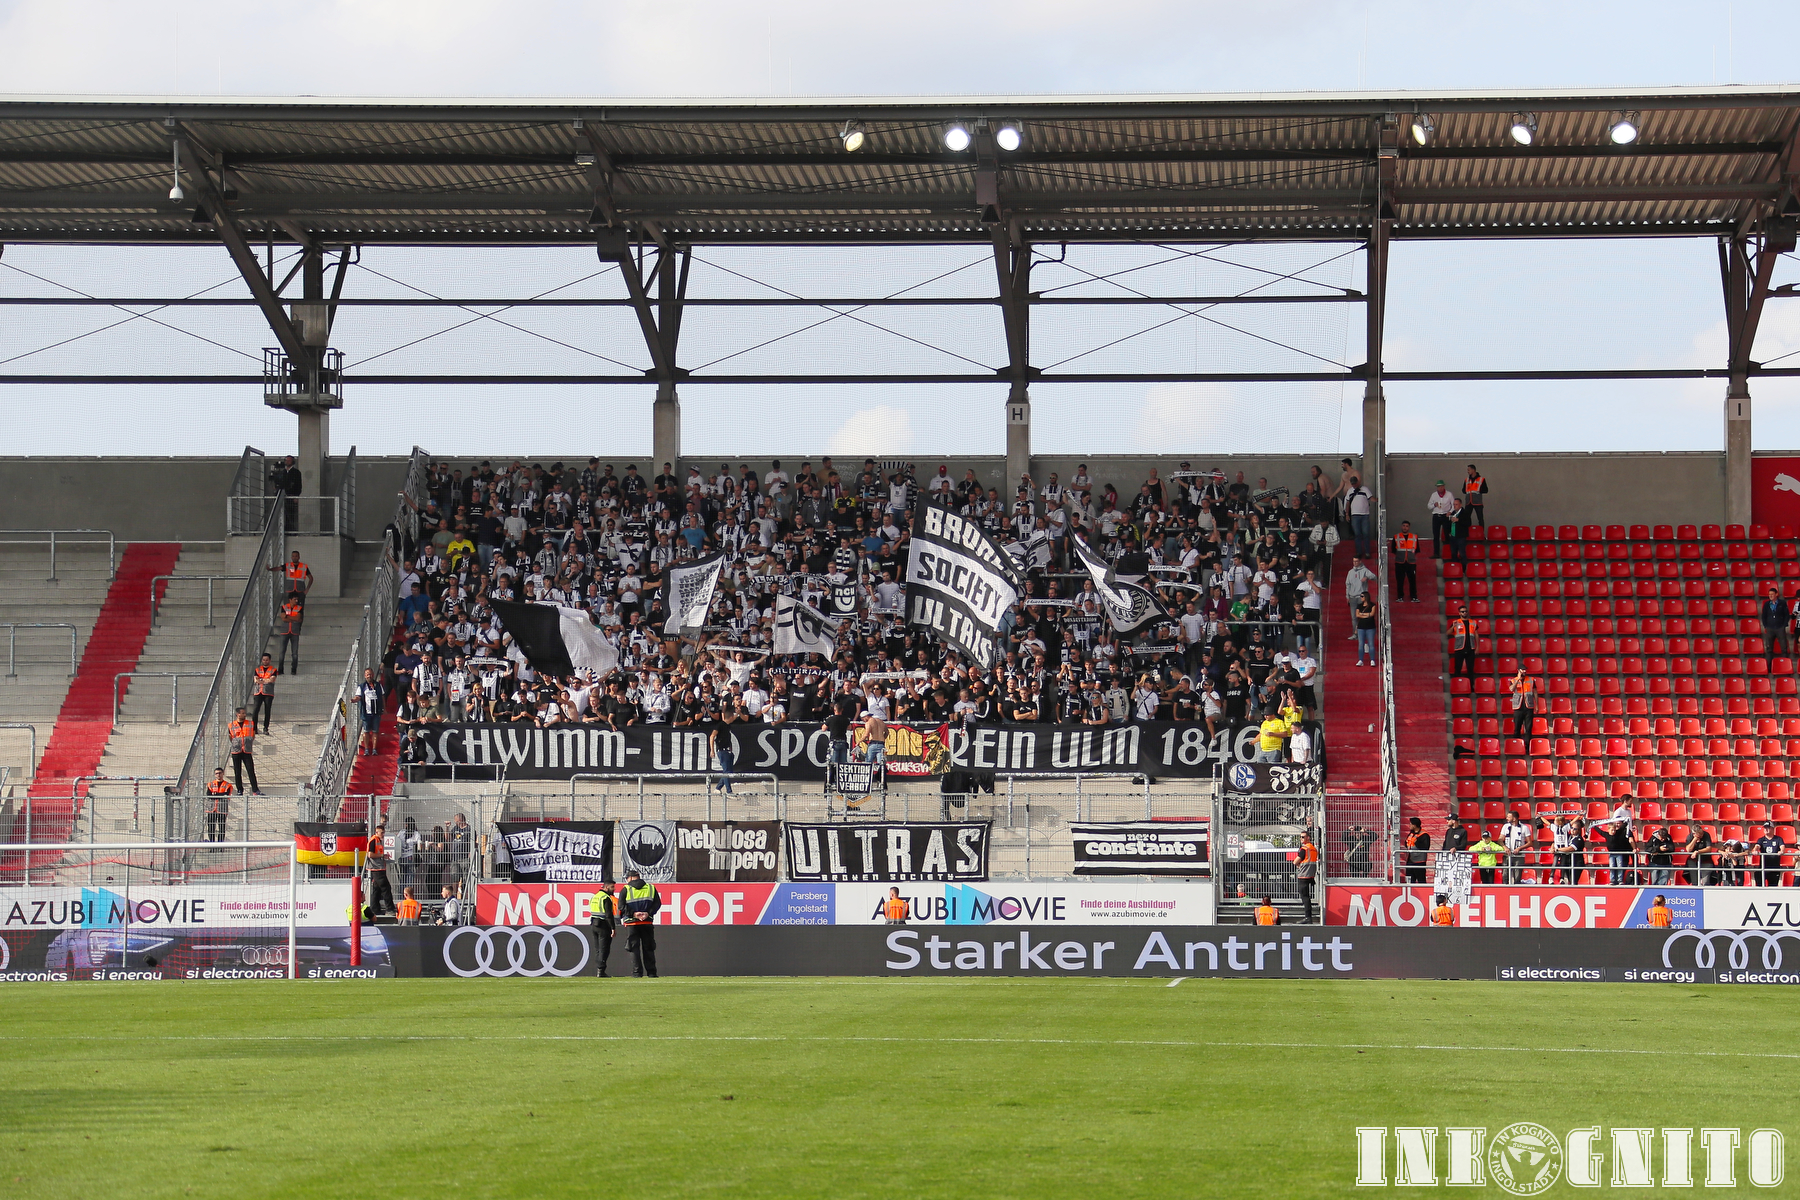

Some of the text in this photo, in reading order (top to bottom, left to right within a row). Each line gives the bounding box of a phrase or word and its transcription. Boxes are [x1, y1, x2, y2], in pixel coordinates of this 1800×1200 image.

[1012, 407, 1023, 421] H
[917, 551, 1003, 620] SOCIETY
[913, 595, 993, 669] ULTRAS
[1161, 725, 1262, 766] 1846
[839, 764, 871, 774] SEKTION
[839, 773, 870, 783] STADION
[839, 782, 869, 791] VERBOT
[384, 838, 394, 847] 42
[677, 823, 768, 850] nebulosa
[1127, 833, 1158, 842] nero
[1227, 836, 1238, 845] 43
[507, 830, 601, 857] Die Ultras
[1085, 840, 1197, 857] constante
[791, 828, 981, 874] ULTRAS
[1229, 849, 1236, 857] N
[708, 848, 776, 882] impero
[548, 865, 601, 881] immer
[889, 873, 954, 881] SOCIETY
[790, 892, 828, 902] Parsberg
[1663, 896, 1696, 907] arsberg
[219, 901, 242, 911] Finde
[243, 901, 267, 911] deine
[494, 884, 744, 926] MÖBHOF
[787, 904, 828, 914] Ingolstadt
[970, 896, 1066, 921] MOVIE
[1080, 899, 1176, 911] Finde deine Ausbildung!
[5, 899, 205, 925] AZUBI MOVIE
[229, 911, 308, 919] www.azubimov.de
[1090, 910, 1168, 918] www.azubimovie.de
[771, 916, 828, 925] moebelhof.de
[885, 929, 1353, 971] Starker Antritt
[92, 969, 163, 982] si energy
[186, 967, 284, 980] si electronics
[308, 967, 377, 979] si energy
[1501, 966, 1600, 979] si electronics
[1624, 968, 1695, 983] si energy
[1719, 970, 1733, 983] si
